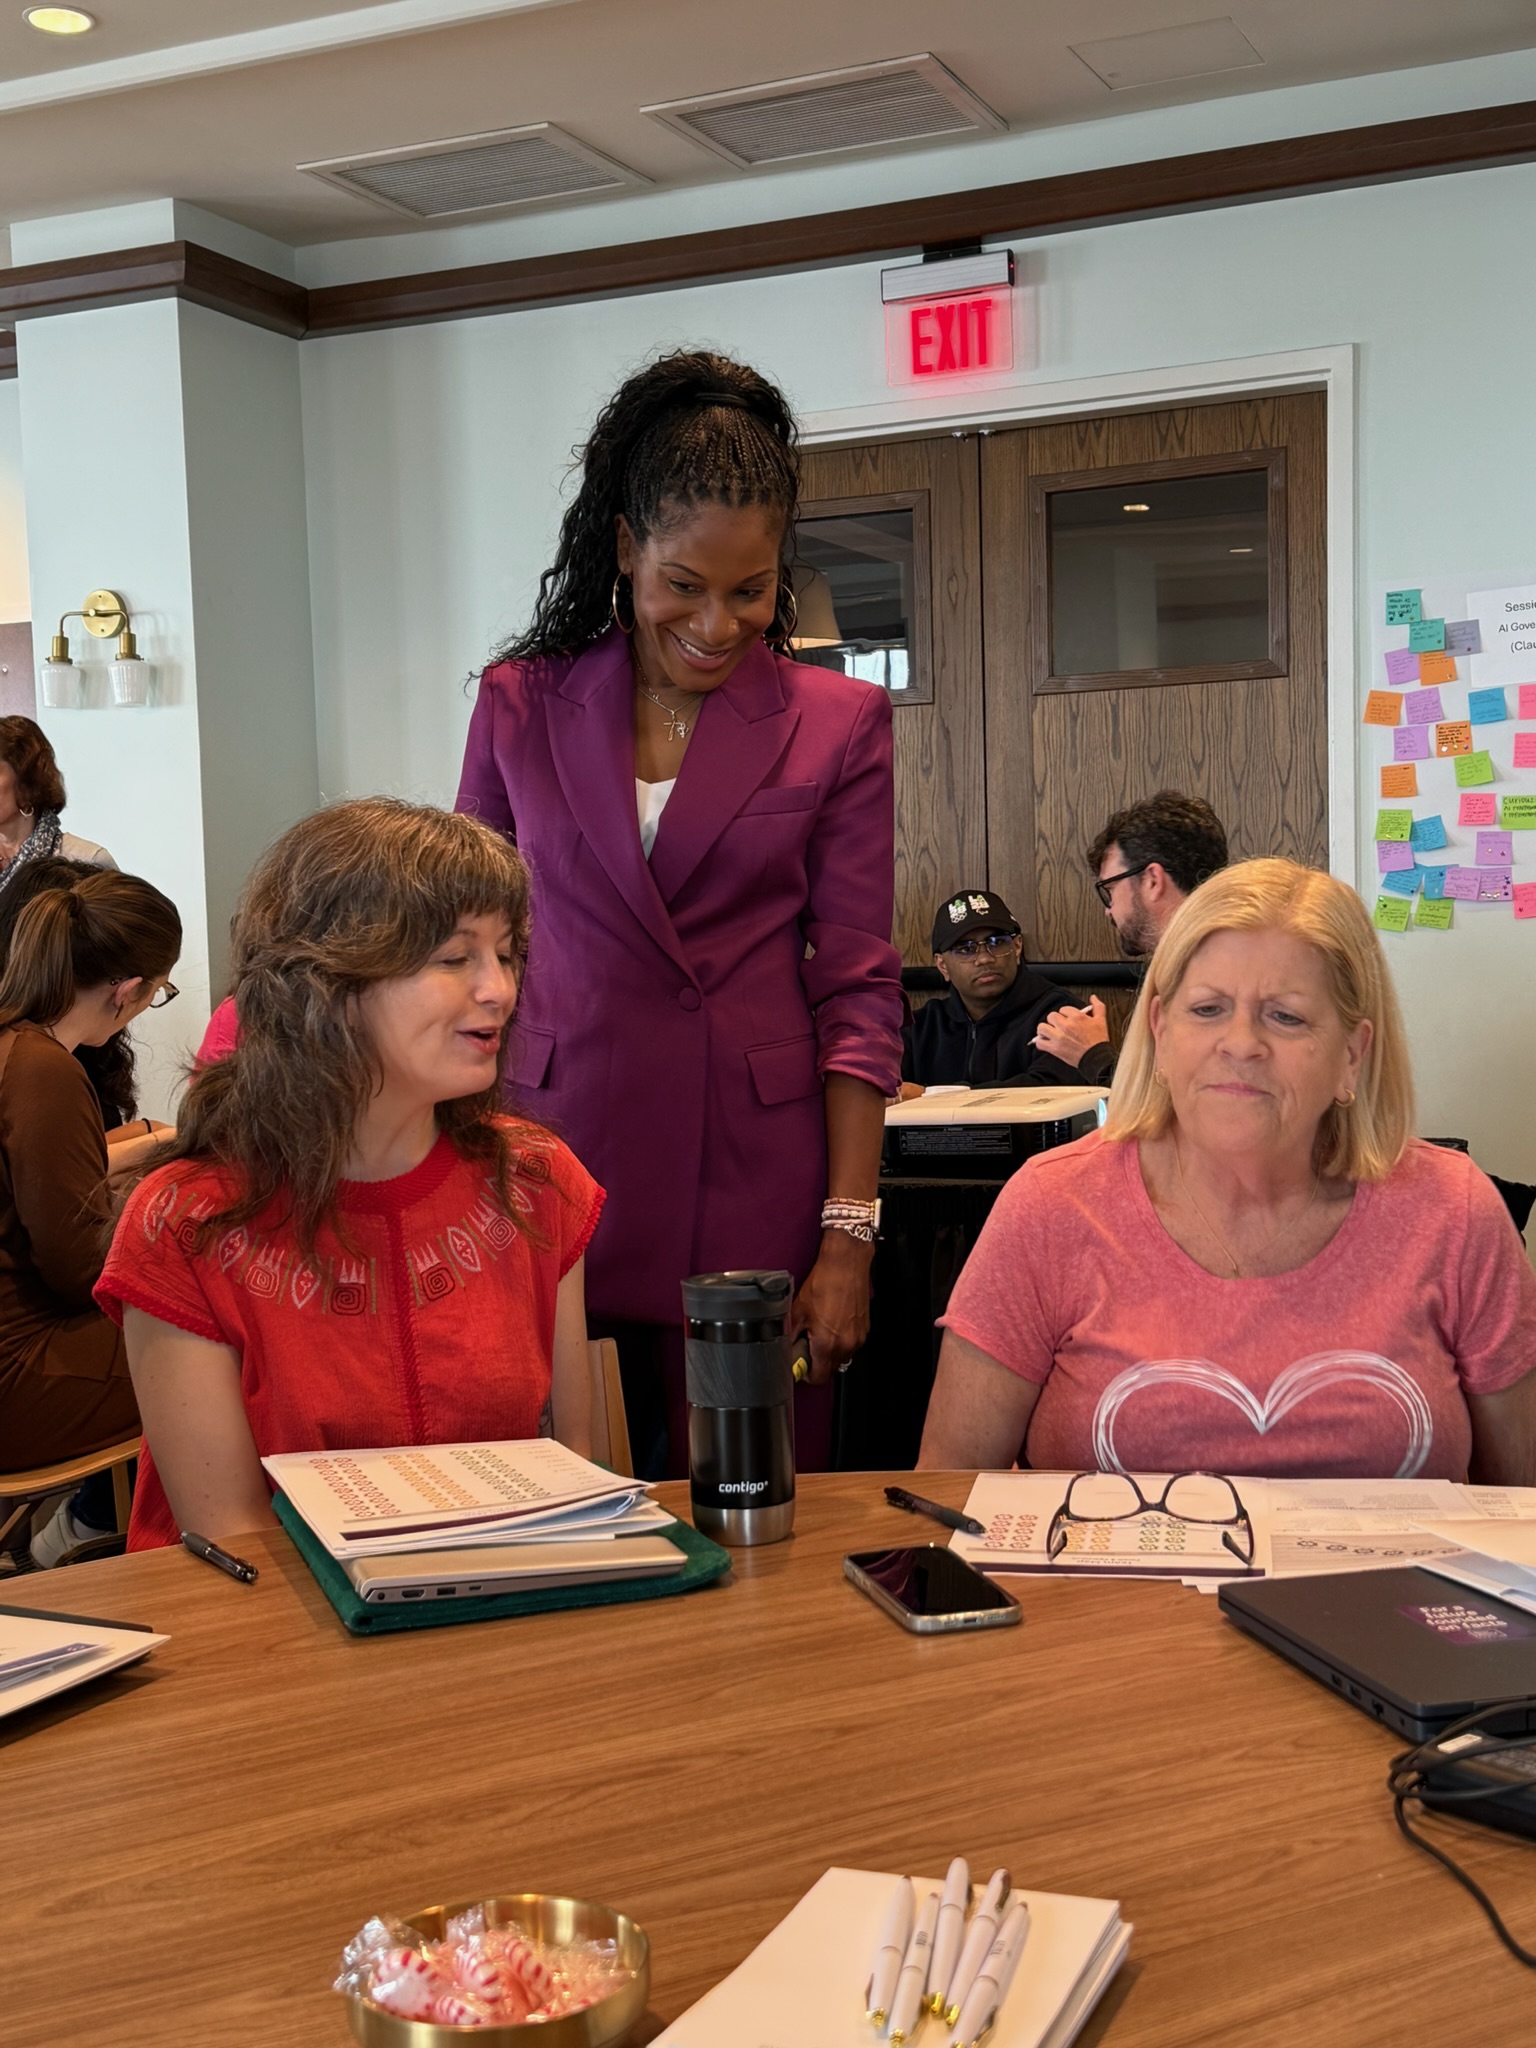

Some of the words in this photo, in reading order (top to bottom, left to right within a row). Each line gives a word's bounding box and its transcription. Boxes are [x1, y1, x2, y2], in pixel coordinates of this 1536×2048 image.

[911, 298, 992, 375] EXIT
[1498, 624, 1509, 633] AI
[718, 1480, 765, 1495] contigo
[1425, 1610, 1478, 1619] future
[1426, 1613, 1498, 1626] founded
[1437, 1624, 1461, 1632] on
[1462, 1620, 1508, 1629] facts
